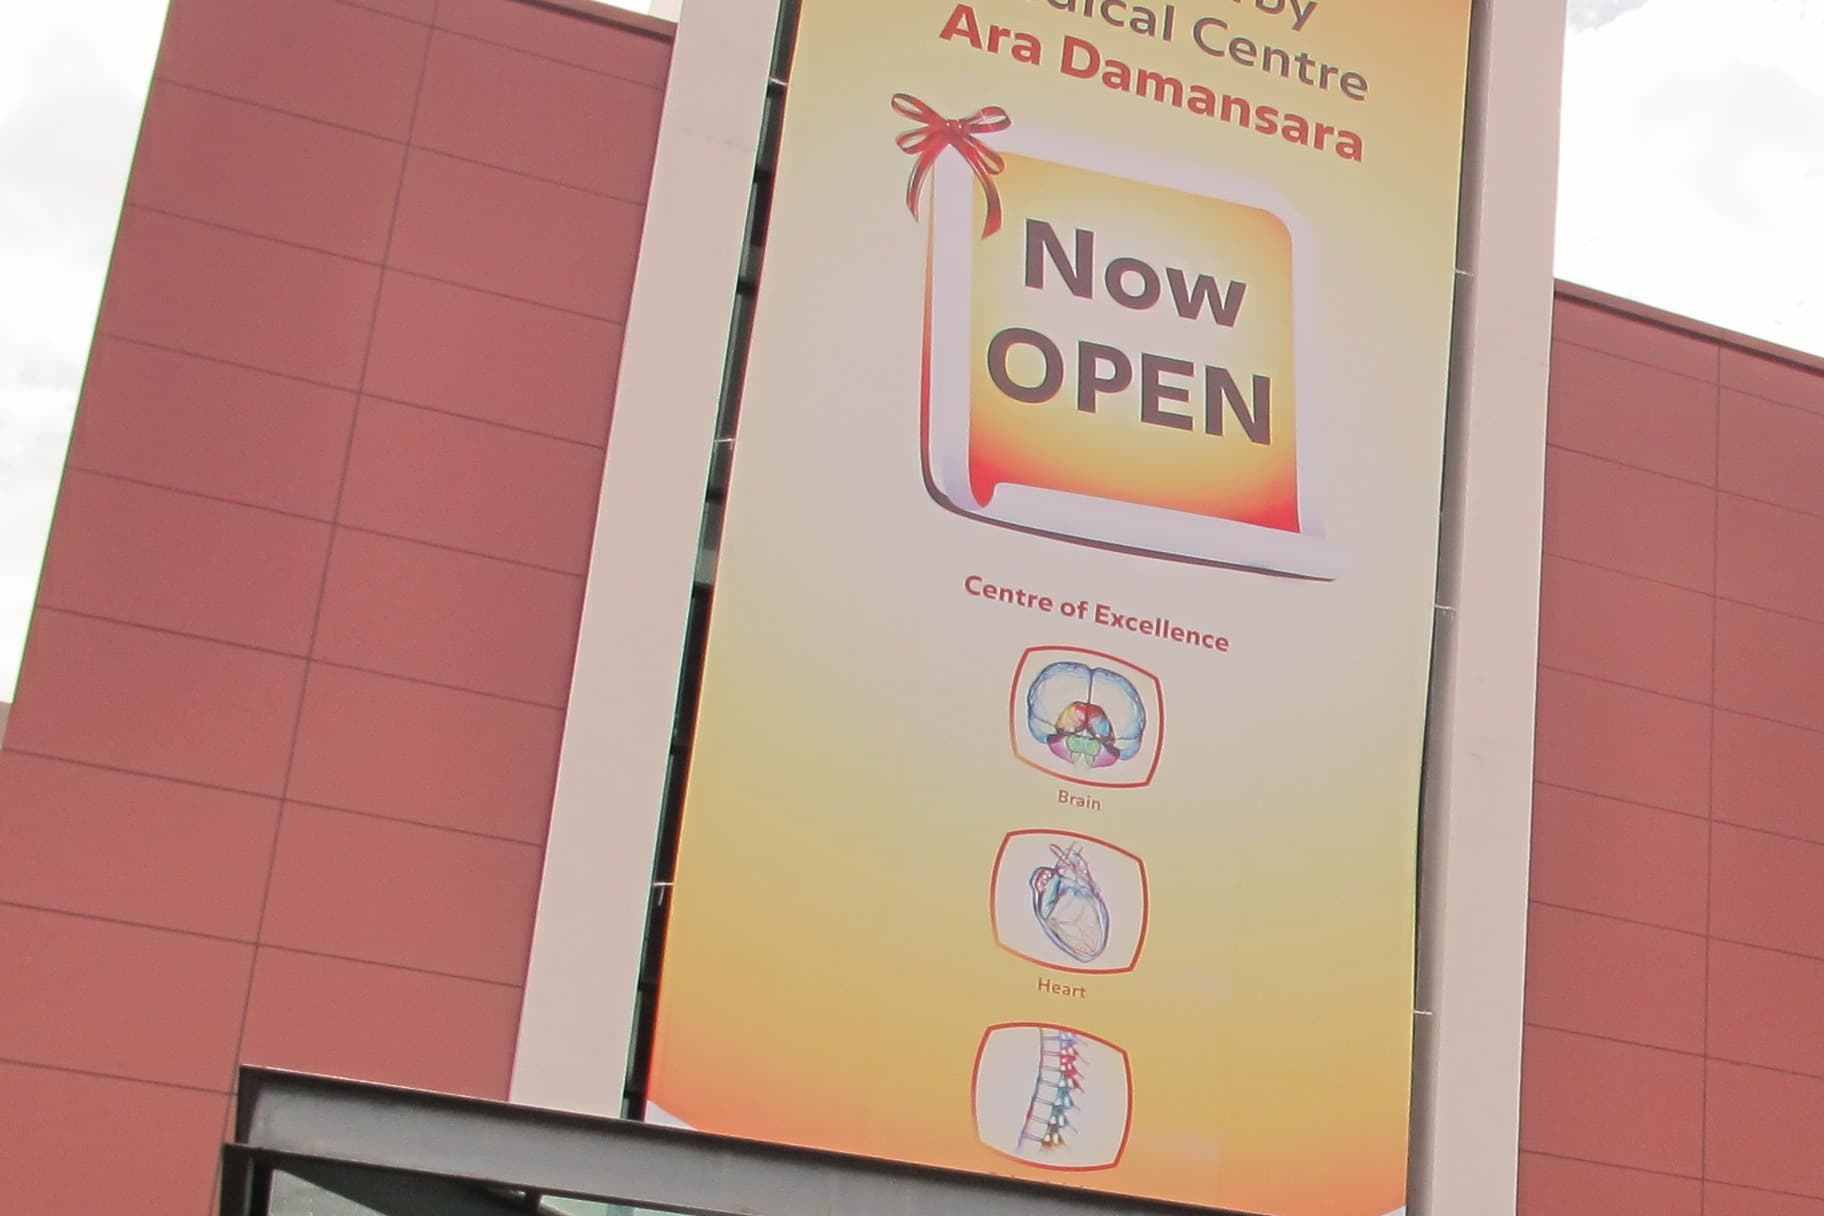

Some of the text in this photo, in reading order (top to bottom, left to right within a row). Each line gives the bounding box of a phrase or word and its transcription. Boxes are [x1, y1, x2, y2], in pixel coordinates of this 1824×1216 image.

[939, 4, 1364, 162] Ara Damansara
[1192, 16, 1369, 101] Centre
[1025, 218, 1247, 328] Now
[987, 327, 1271, 446] OPEN
[964, 575, 1230, 652] Centre of Excellence
[1058, 789, 1101, 811] Brain
[1037, 976, 1087, 1000] Heart
